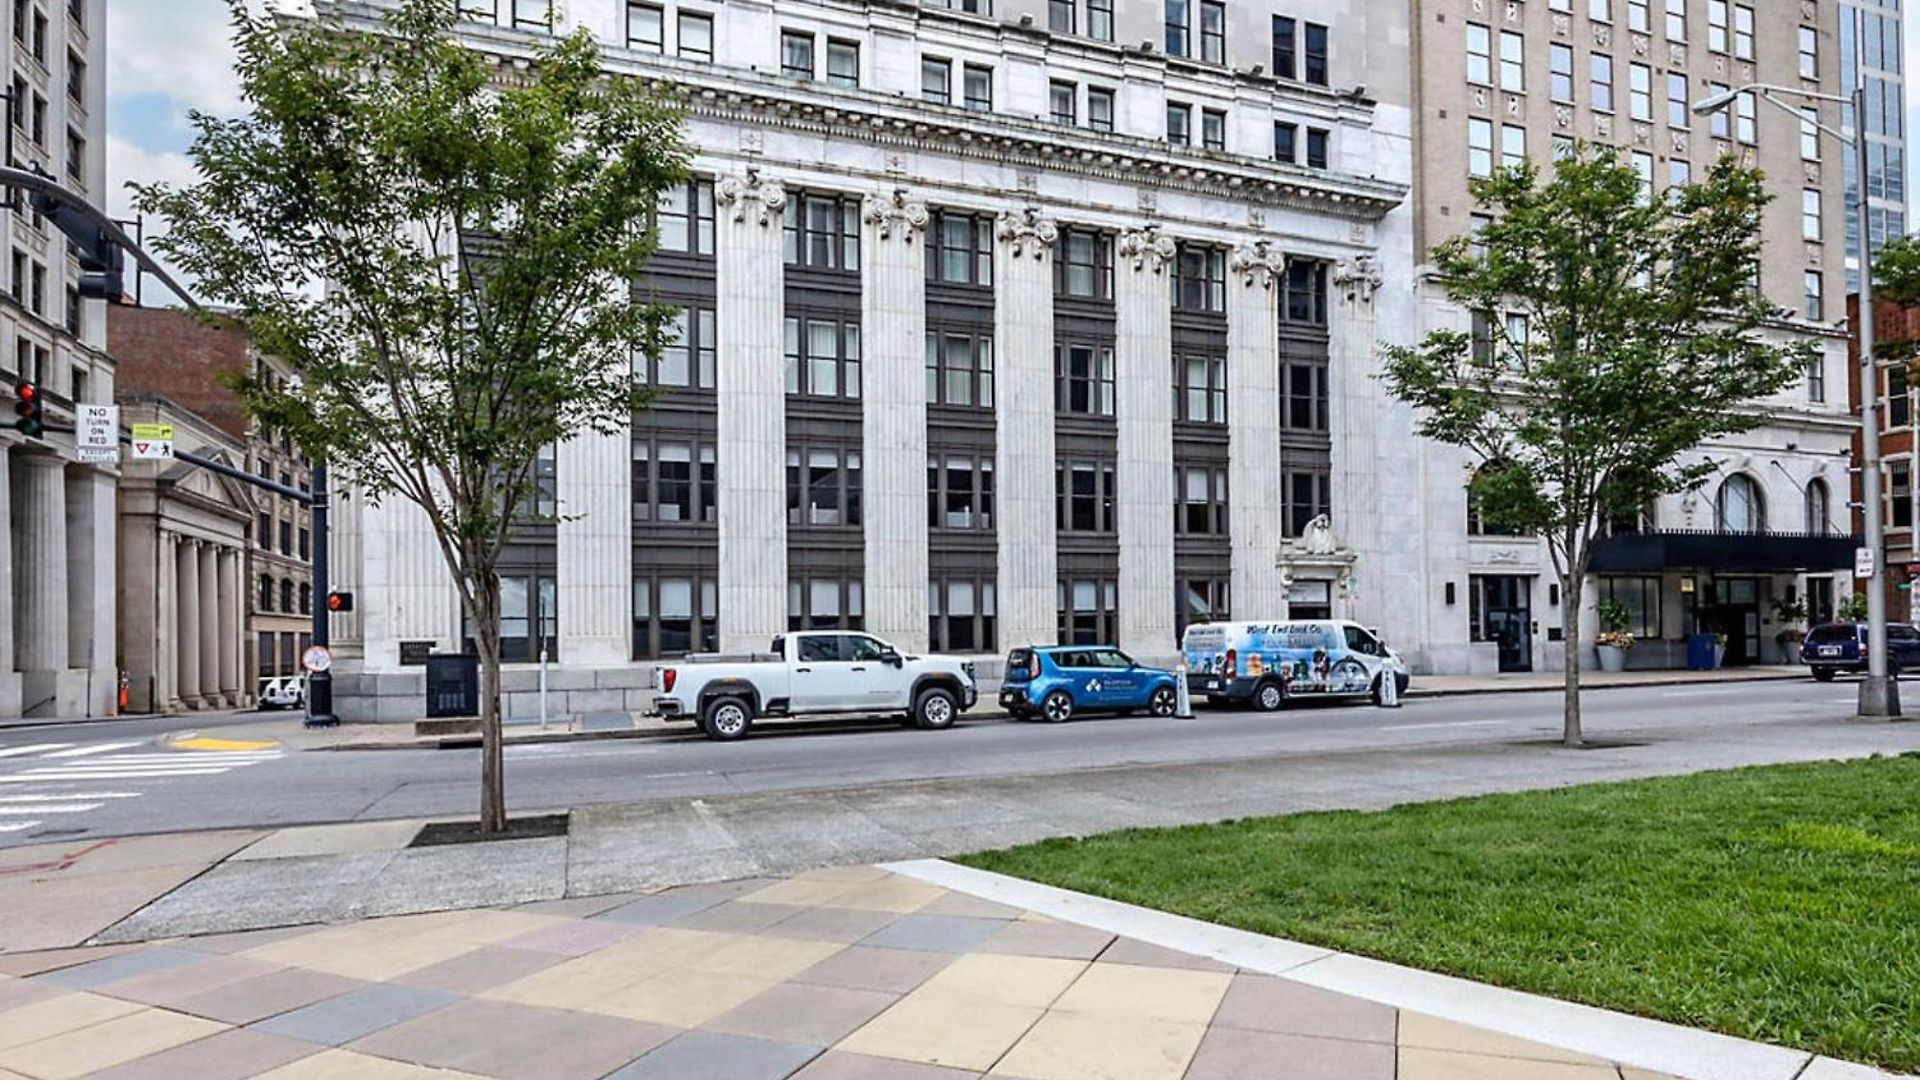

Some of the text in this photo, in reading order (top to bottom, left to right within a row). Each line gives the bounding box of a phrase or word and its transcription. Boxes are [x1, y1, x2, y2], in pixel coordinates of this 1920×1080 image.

[89, 408, 106, 417] NO
[90, 427, 105, 435] ON
[88, 436, 107, 445] RED
